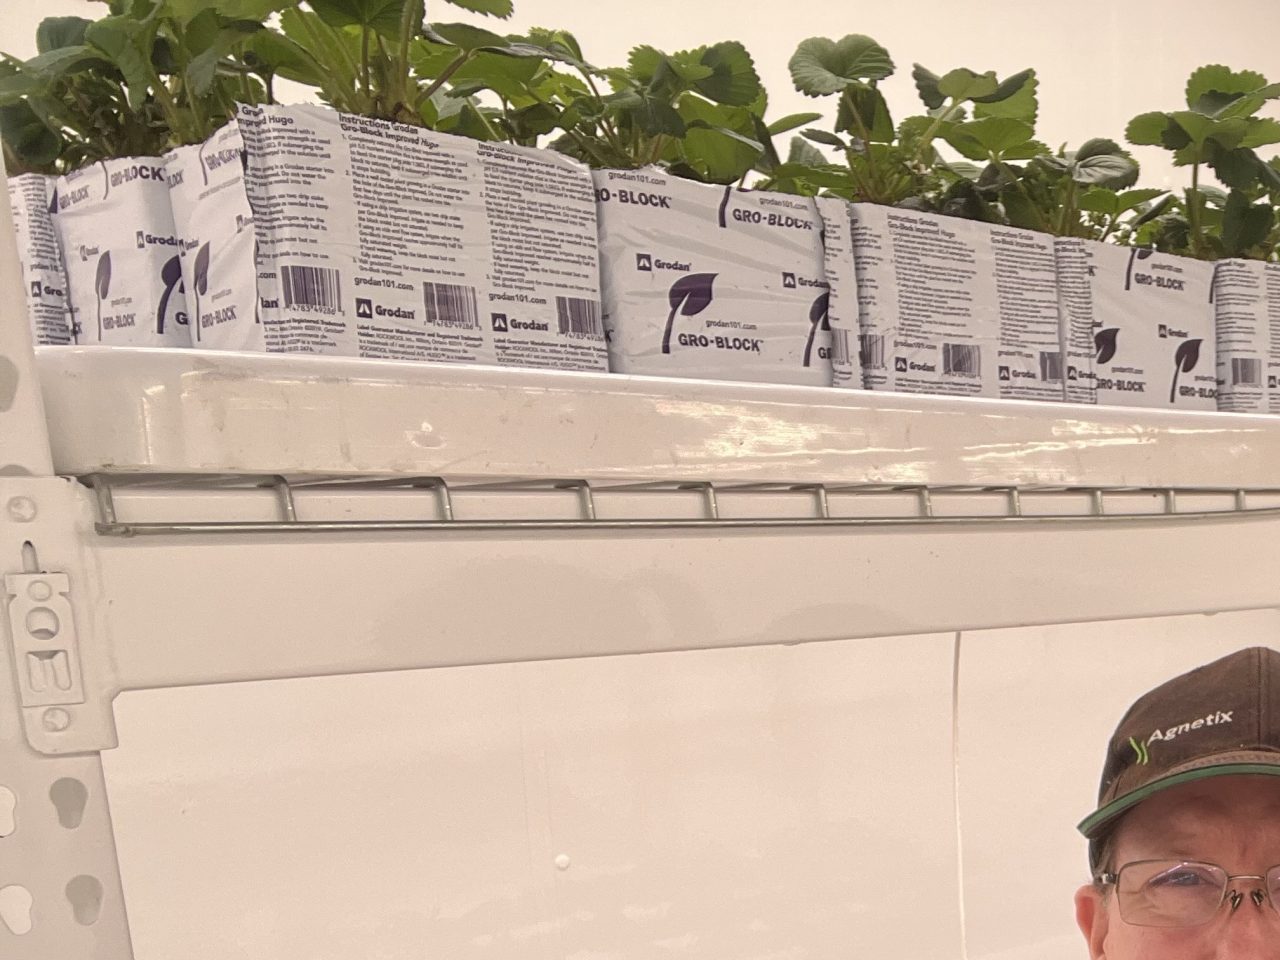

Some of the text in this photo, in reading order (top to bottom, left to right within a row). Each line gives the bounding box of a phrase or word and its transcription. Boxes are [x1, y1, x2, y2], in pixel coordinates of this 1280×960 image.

[268, 114, 294, 126] Hugo
[338, 112, 391, 130] Instructions
[340, 123, 383, 138] Gro-Block
[385, 131, 420, 146] Improved
[608, 172, 666, 186] grodan101.com
[732, 208, 812, 230] GRO-BLOCK
[654, 259, 690, 271] Grodan
[354, 276, 414, 291] grodan101.com
[488, 292, 547, 305] grodan101.com
[375, 305, 414, 320] Grodan
[510, 318, 548, 331] Grodan
[706, 319, 757, 330] grodan101.com
[678, 333, 761, 352] GRO-BLOCK
[1147, 710, 1234, 746] Agnetix
